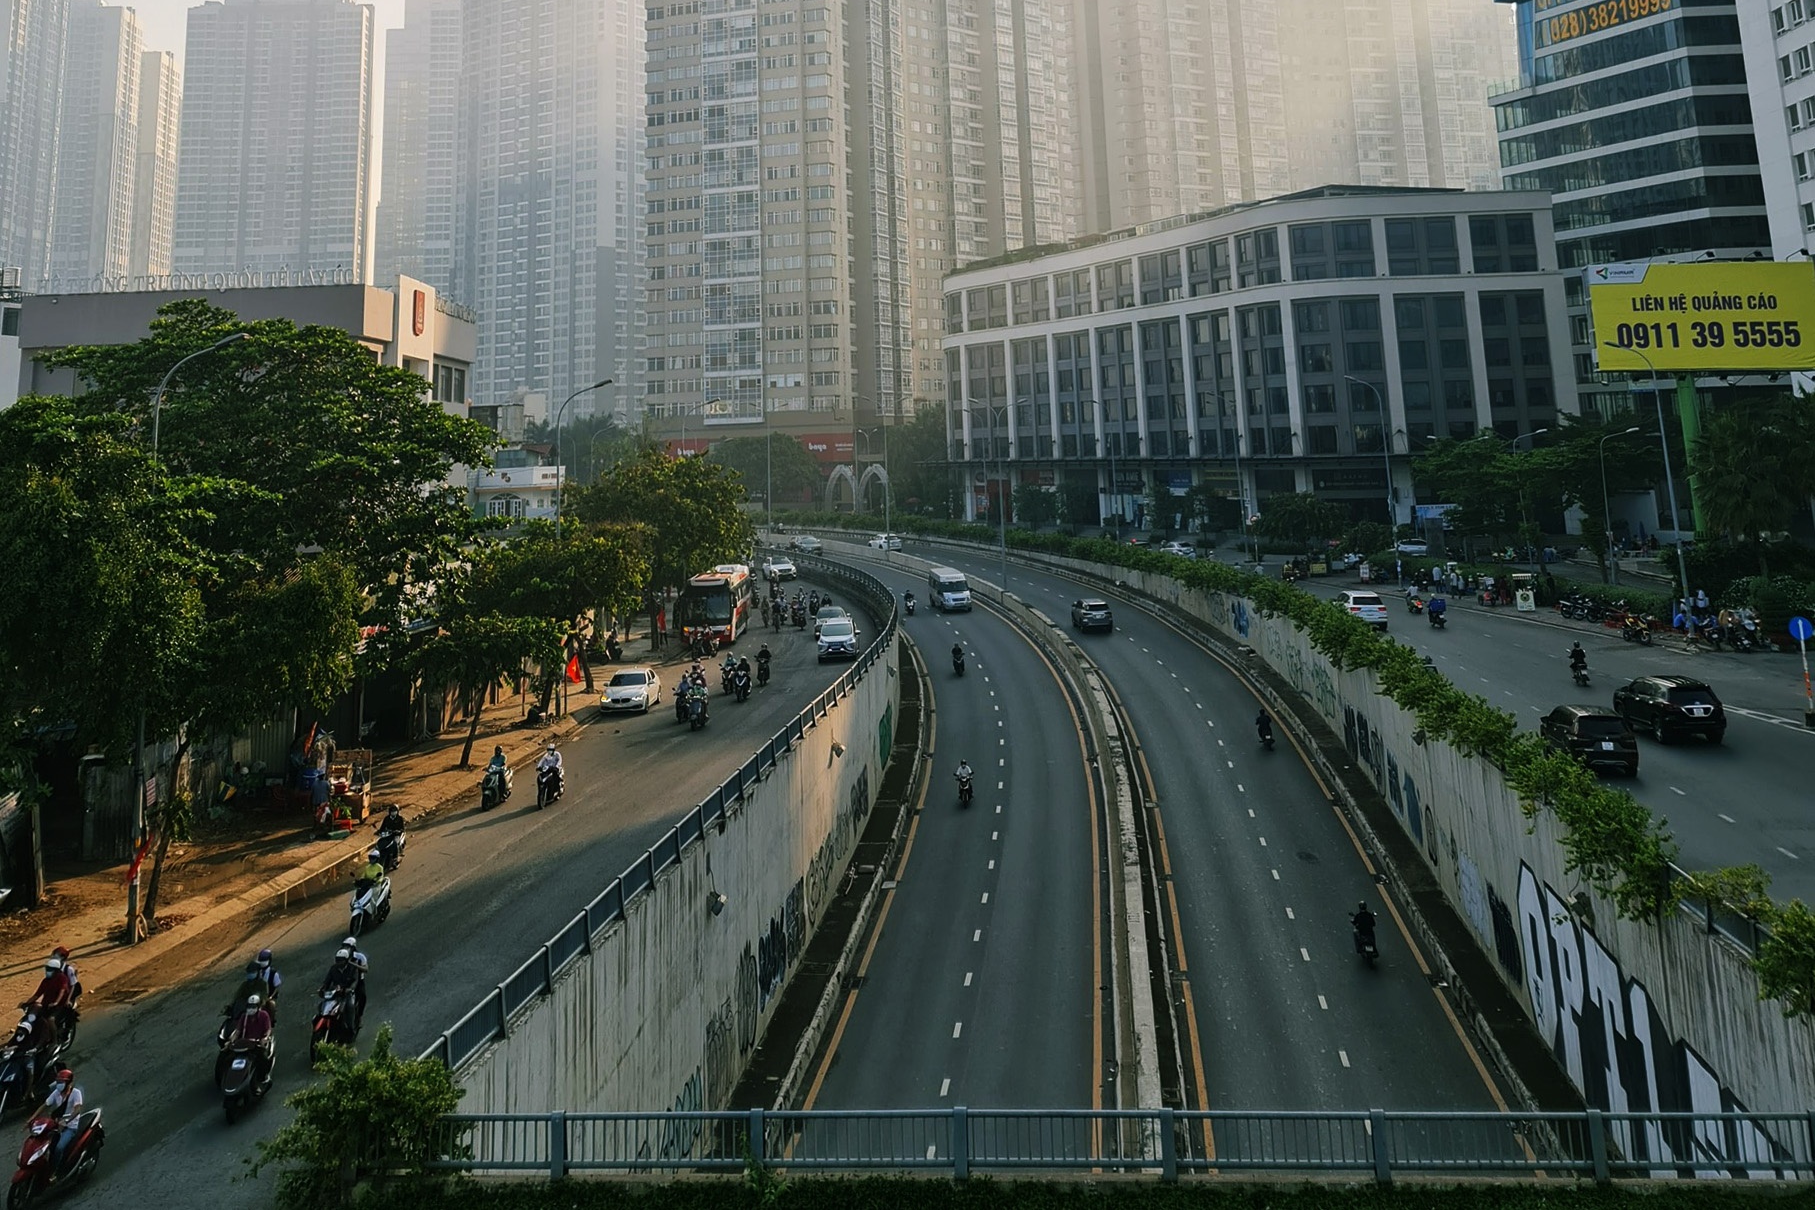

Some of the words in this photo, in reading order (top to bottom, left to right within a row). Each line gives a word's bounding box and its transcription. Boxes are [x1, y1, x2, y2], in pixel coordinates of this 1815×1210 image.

[1632, 294, 1664, 311] LIÊN
[1669, 293, 1687, 313] HỆ
[1692, 291, 1743, 311] QUẢNG
[1747, 292, 1778, 310] CÁO
[1617, 322, 1680, 349] 0911
[1690, 321, 1725, 348] 39
[1732, 321, 1801, 348] 5555
